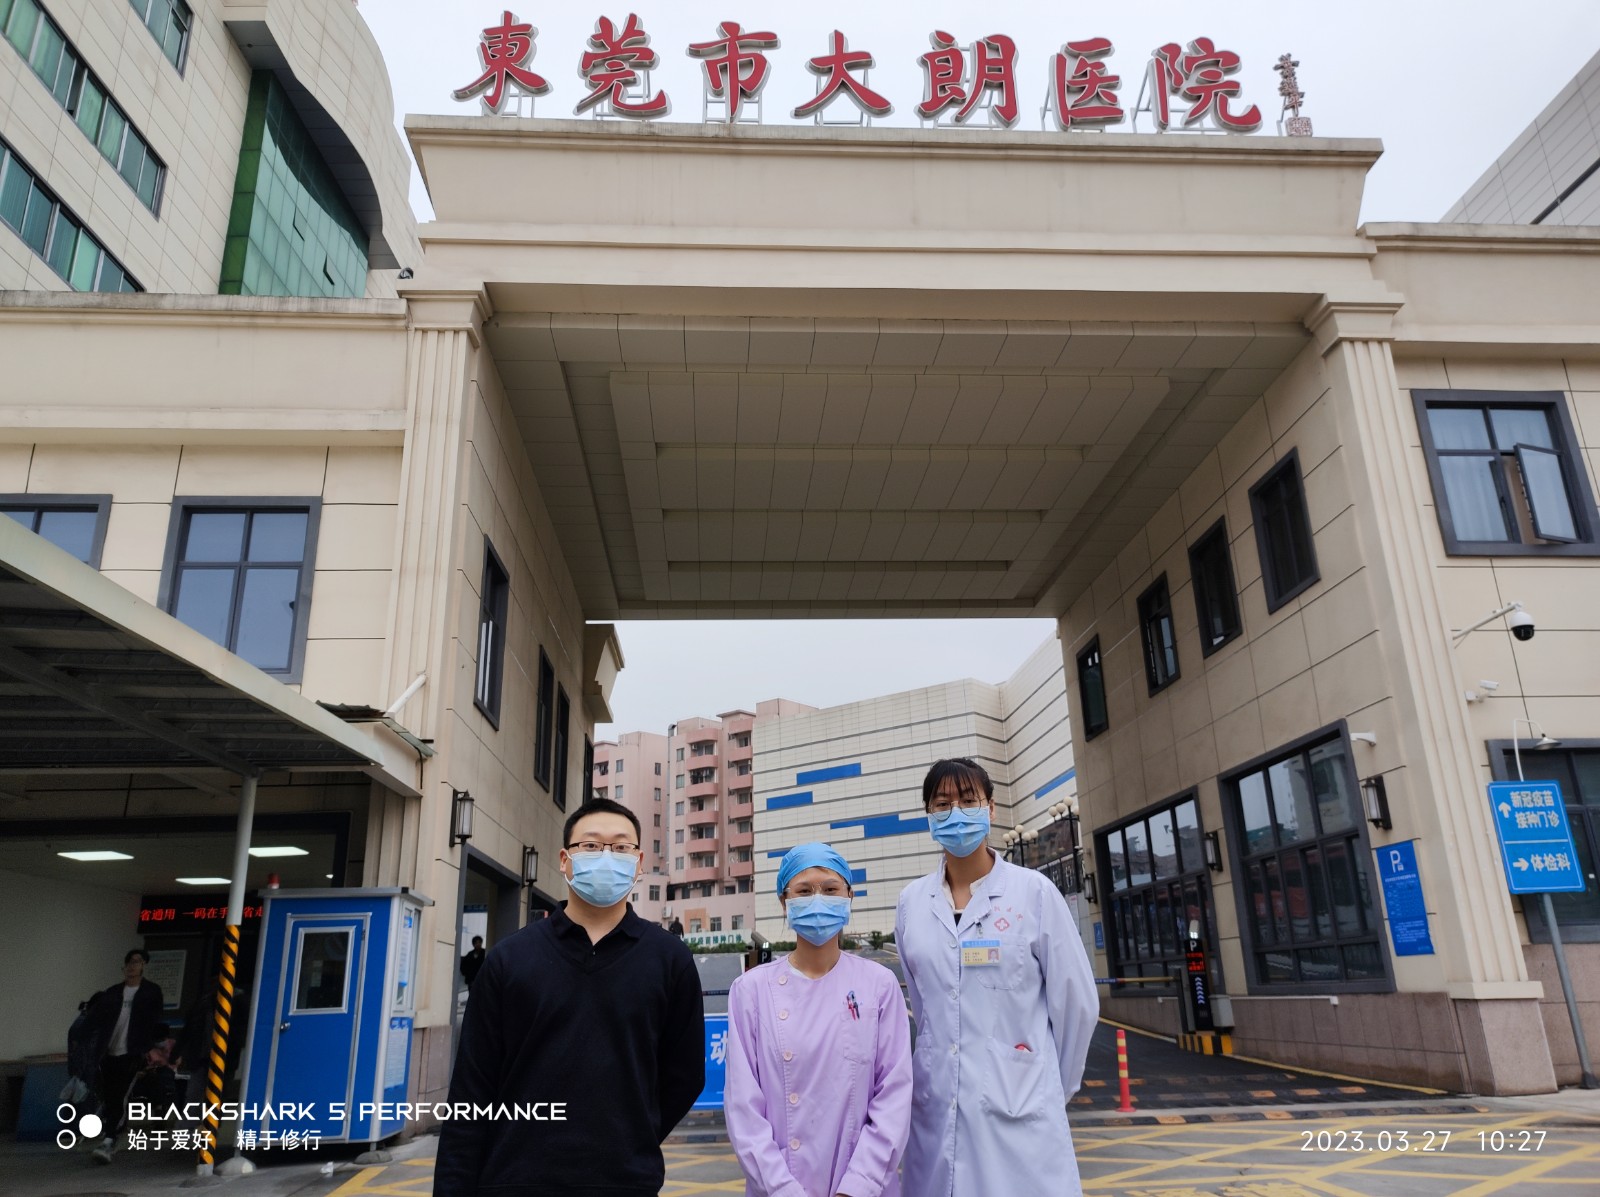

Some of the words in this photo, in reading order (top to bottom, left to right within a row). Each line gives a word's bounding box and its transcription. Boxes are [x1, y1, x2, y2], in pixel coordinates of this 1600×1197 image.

[453, 11, 1262, 132] 東莞市大朗医院
[1510, 790, 1555, 808] 新冠疫苗
[1515, 810, 1560, 828] 接种门诊
[1389, 849, 1401, 873] P
[1530, 853, 1571, 872] 体检科
[140, 908, 176, 921] 省通用
[182, 906, 263, 920] 一码在手省走
[1189, 940, 1197, 951] P
